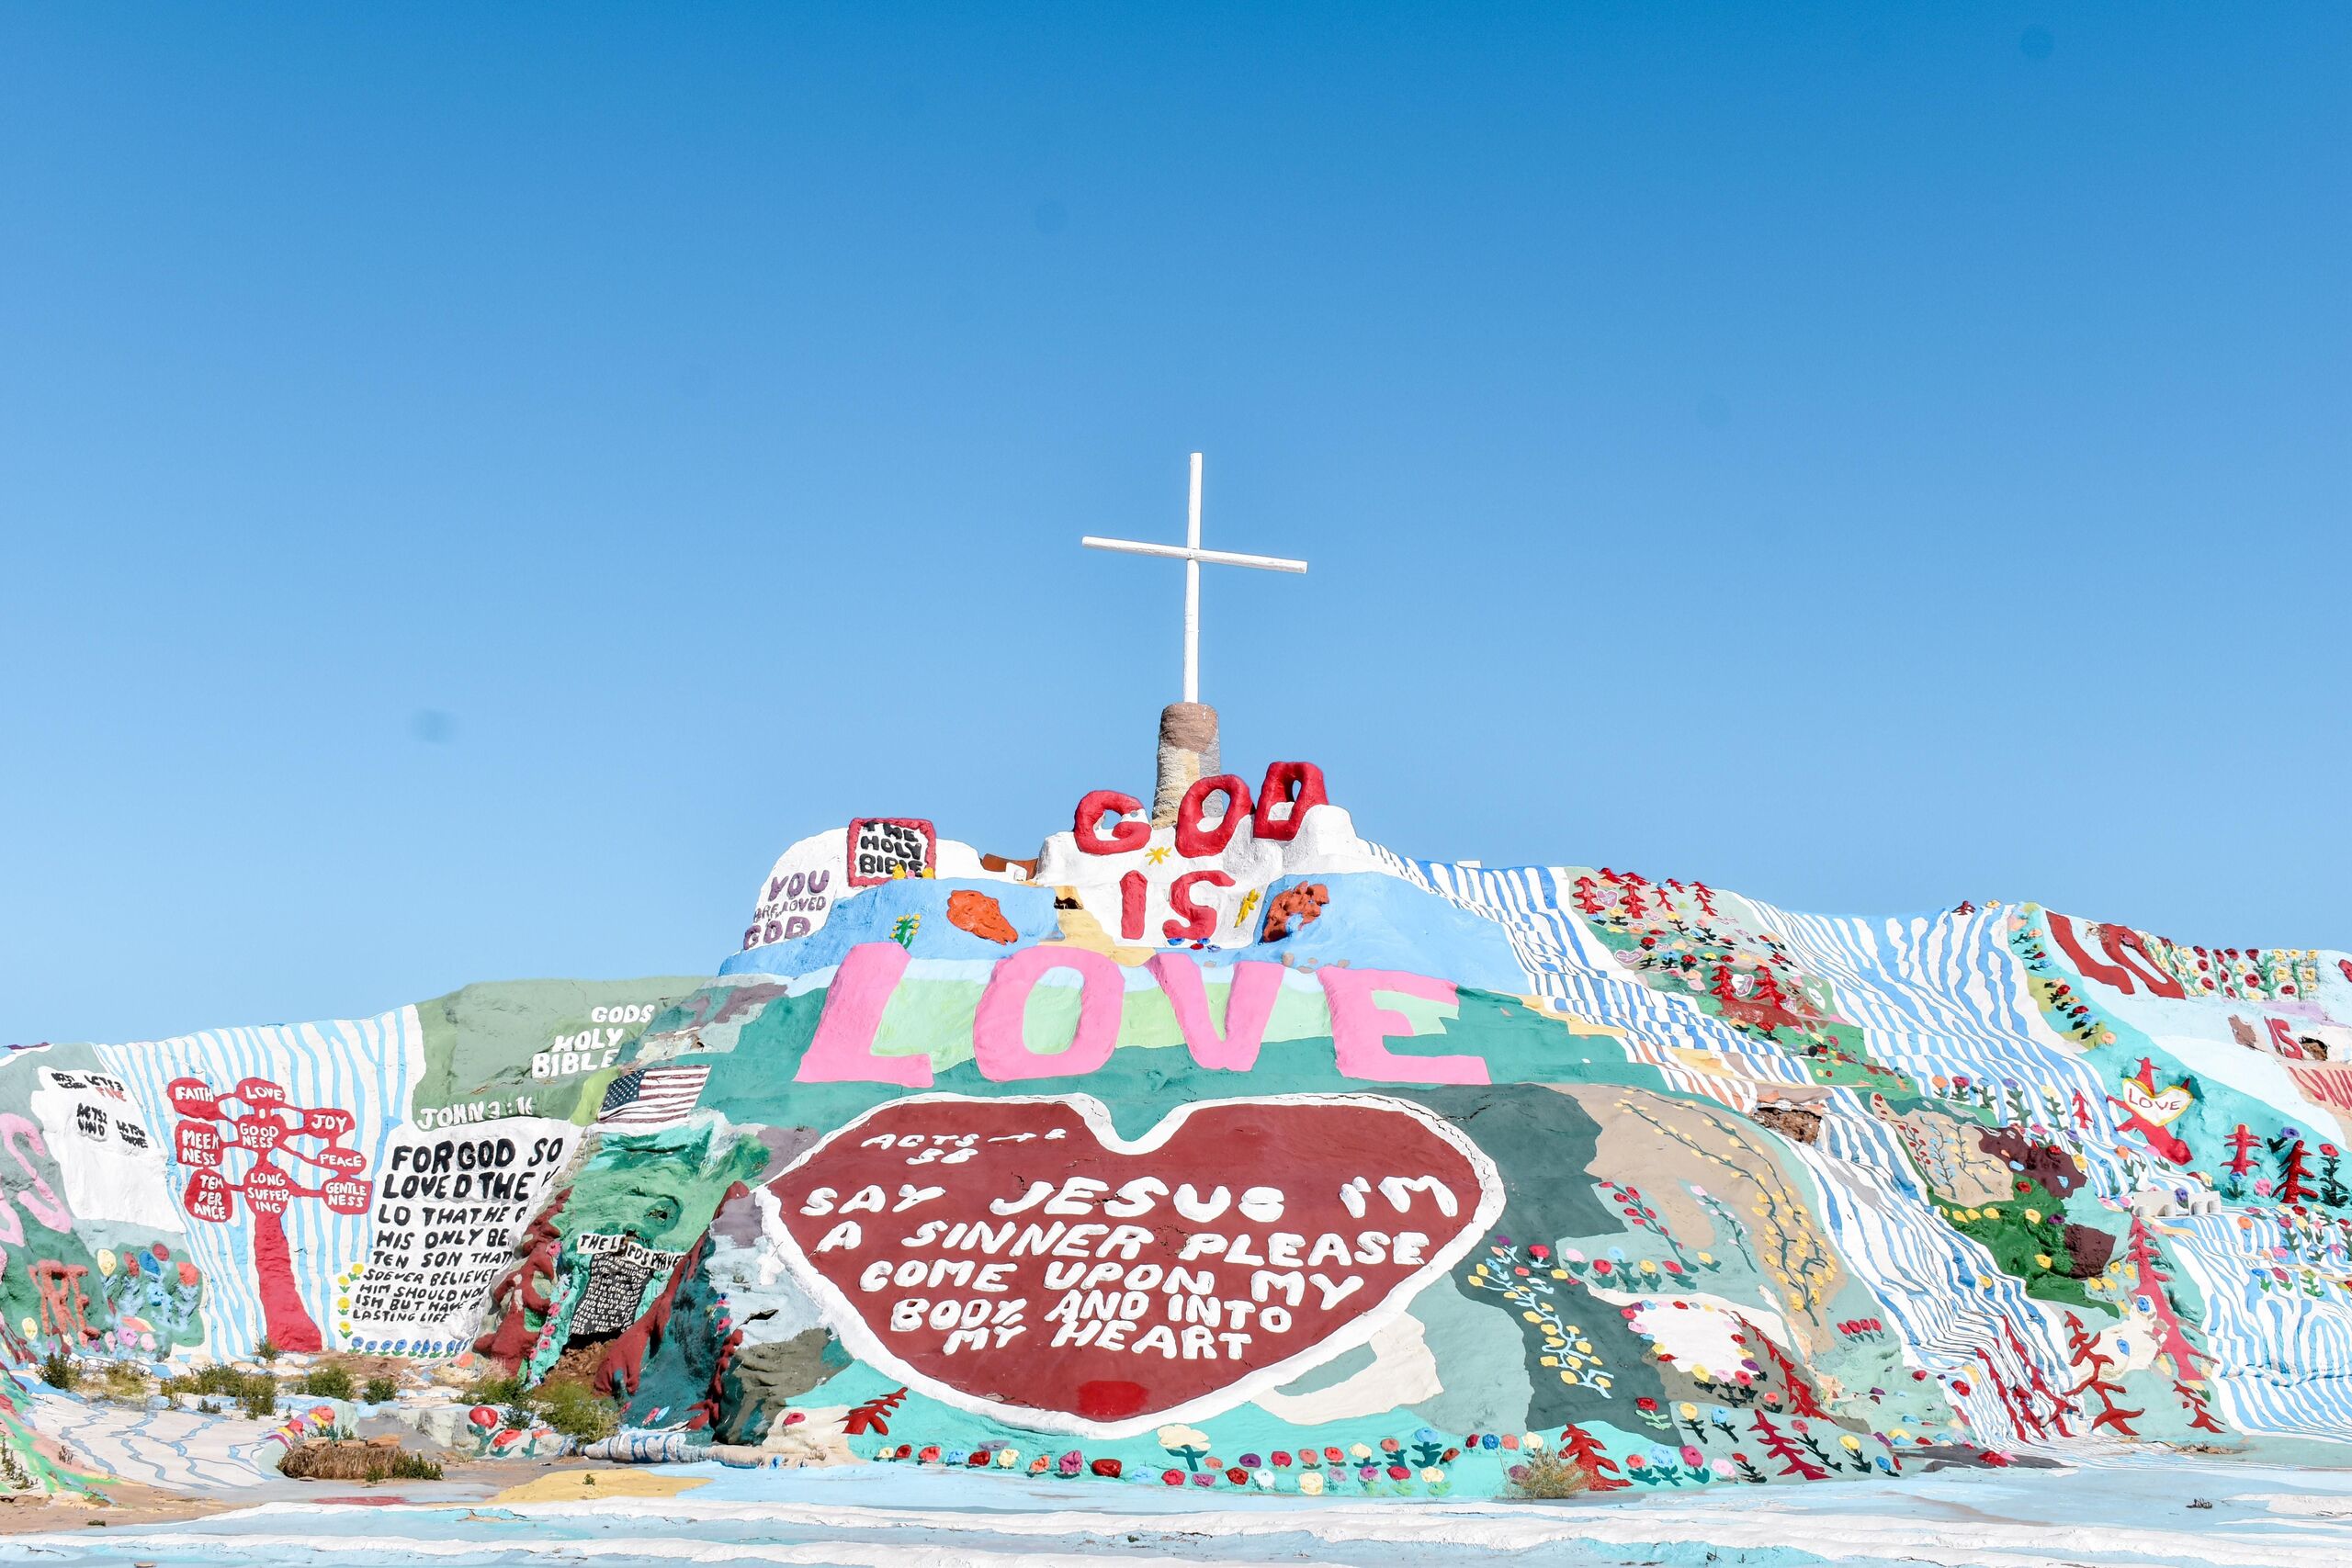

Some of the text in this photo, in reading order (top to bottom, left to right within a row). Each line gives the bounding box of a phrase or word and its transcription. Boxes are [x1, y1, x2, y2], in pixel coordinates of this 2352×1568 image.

[1073, 761, 1329, 859] GOD
[861, 820, 919, 842] THE
[860, 835, 922, 860] HOLY
[768, 869, 830, 901] YOU
[1119, 870, 1236, 940] IS
[743, 915, 811, 950] GOD
[591, 1004, 655, 1023] GODS
[794, 942, 1492, 1088] LOVE
[551, 1027, 624, 1053] HOLY
[531, 1048, 619, 1078] BIBLE
[175, 1086, 214, 1102] FAITH
[245, 1085, 283, 1101] LOVE
[2129, 1088, 2182, 1111] LOVE
[311, 1114, 347, 1132] JOY
[416, 1101, 485, 1130] JOHN
[182, 1129, 220, 1150] MEEK
[240, 1123, 279, 1138] GOOD
[243, 1135, 274, 1147] NESS
[861, 1134, 979, 1149] ACTS
[182, 1149, 216, 1166] NESS
[320, 1154, 362, 1168] PEACE
[391, 1137, 564, 1174] FOR GOD SO
[199, 1175, 224, 1190] TEM
[250, 1172, 286, 1187] LONG
[325, 1182, 367, 1196] GENTLE
[382, 1173, 473, 1200] LOVED
[479, 1171, 537, 1202] THE
[247, 1187, 289, 1201] SUFFER
[328, 1195, 365, 1208] NESS
[799, 1175, 1458, 1223] SAY JESUS I'M
[194, 1205, 227, 1221] ANCE
[255, 1201, 282, 1213] ING
[422, 1206, 482, 1226] THAT
[483, 1206, 510, 1223] HE
[377, 1228, 510, 1250] HIS ONLY BE
[581, 1235, 608, 1250] THE
[816, 1220, 1430, 1268] A SINNER PLEASE
[373, 1250, 409, 1269] TEN
[421, 1252, 463, 1268] SON
[363, 1269, 424, 1283] SOEVER
[859, 1258, 1364, 1311] COME UPON MY
[359, 1284, 390, 1294] HIM
[393, 1286, 458, 1302] SHOULD
[356, 1294, 384, 1309] ISH
[390, 1299, 424, 1311] BUT
[428, 1299, 466, 1313] HAVE
[890, 1289, 1292, 1333] BODY AND INTO
[353, 1309, 450, 1323] LASTING LIFE
[943, 1319, 1252, 1359] MY HEART
